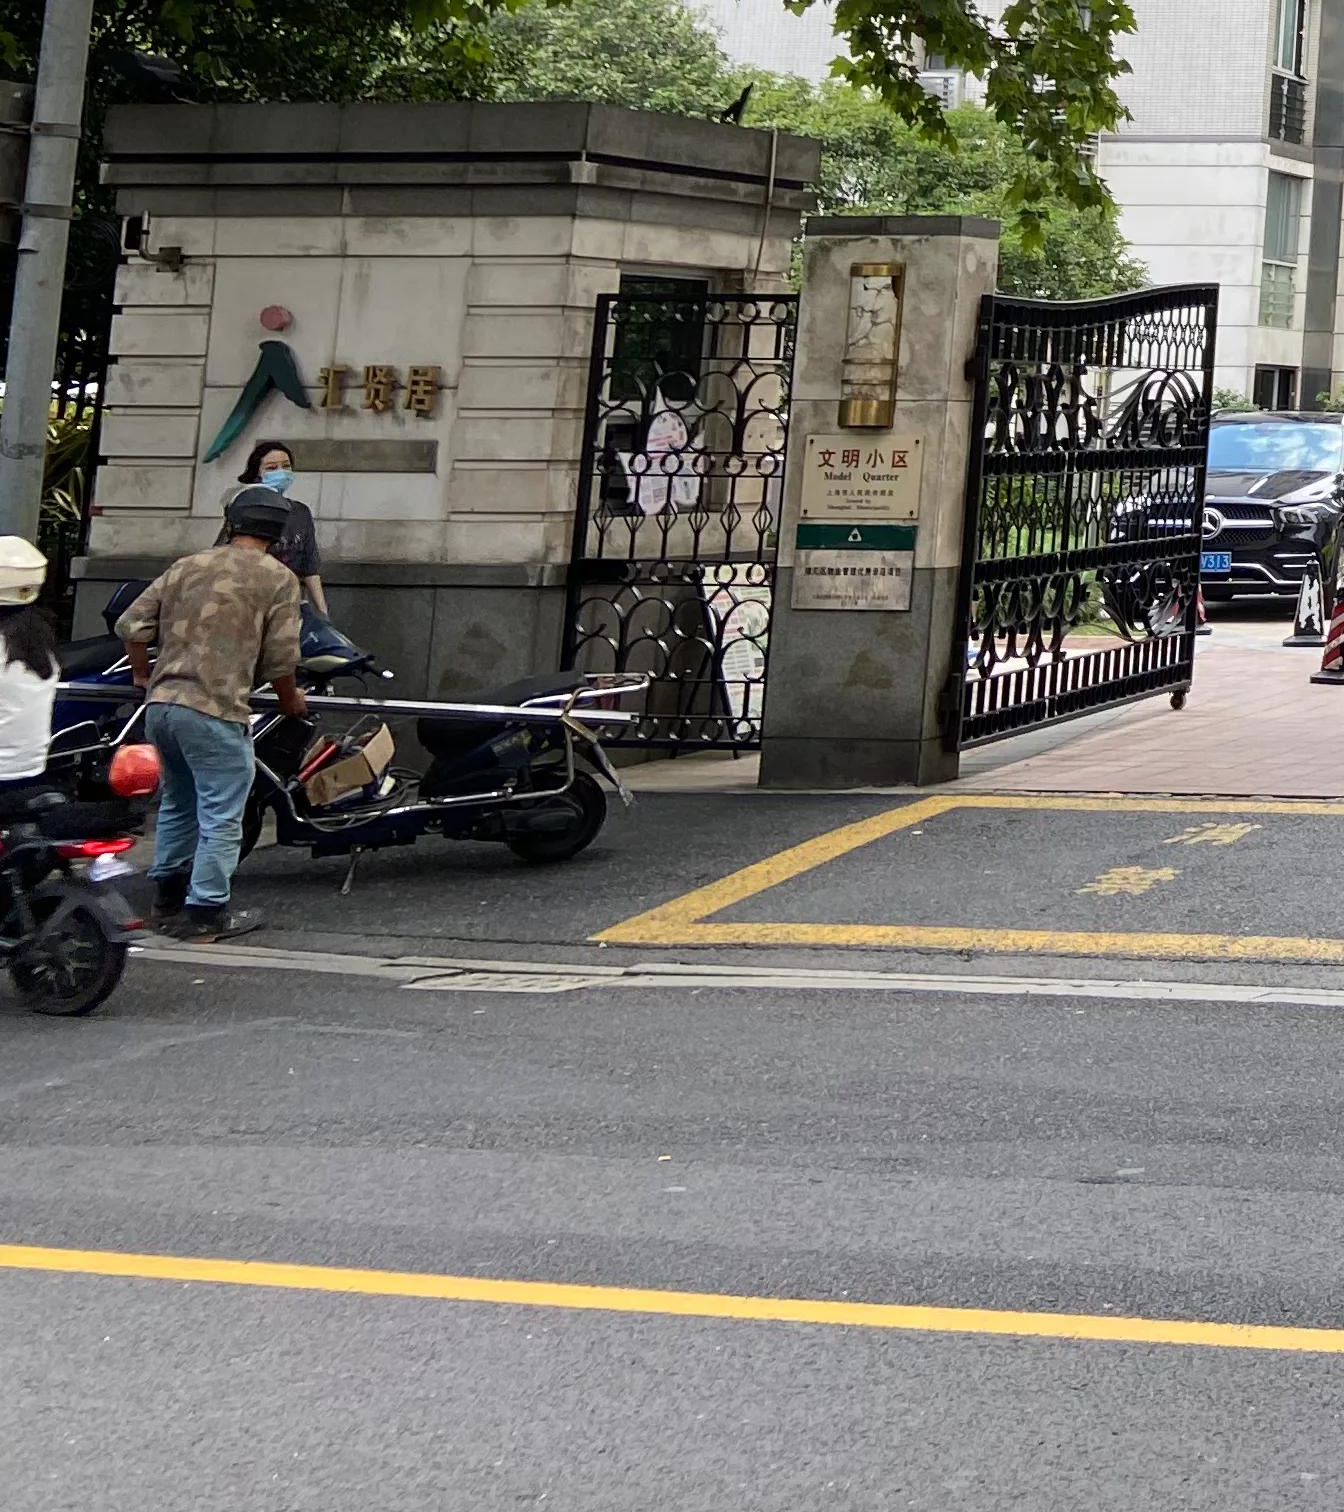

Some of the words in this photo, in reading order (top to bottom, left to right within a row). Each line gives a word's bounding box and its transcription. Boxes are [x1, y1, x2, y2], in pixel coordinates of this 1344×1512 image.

[319, 364, 442, 413] 汇贤居
[817, 448, 909, 468] 文明小区
[823, 471, 852, 481] Model
[862, 472, 900, 483] Quarter
